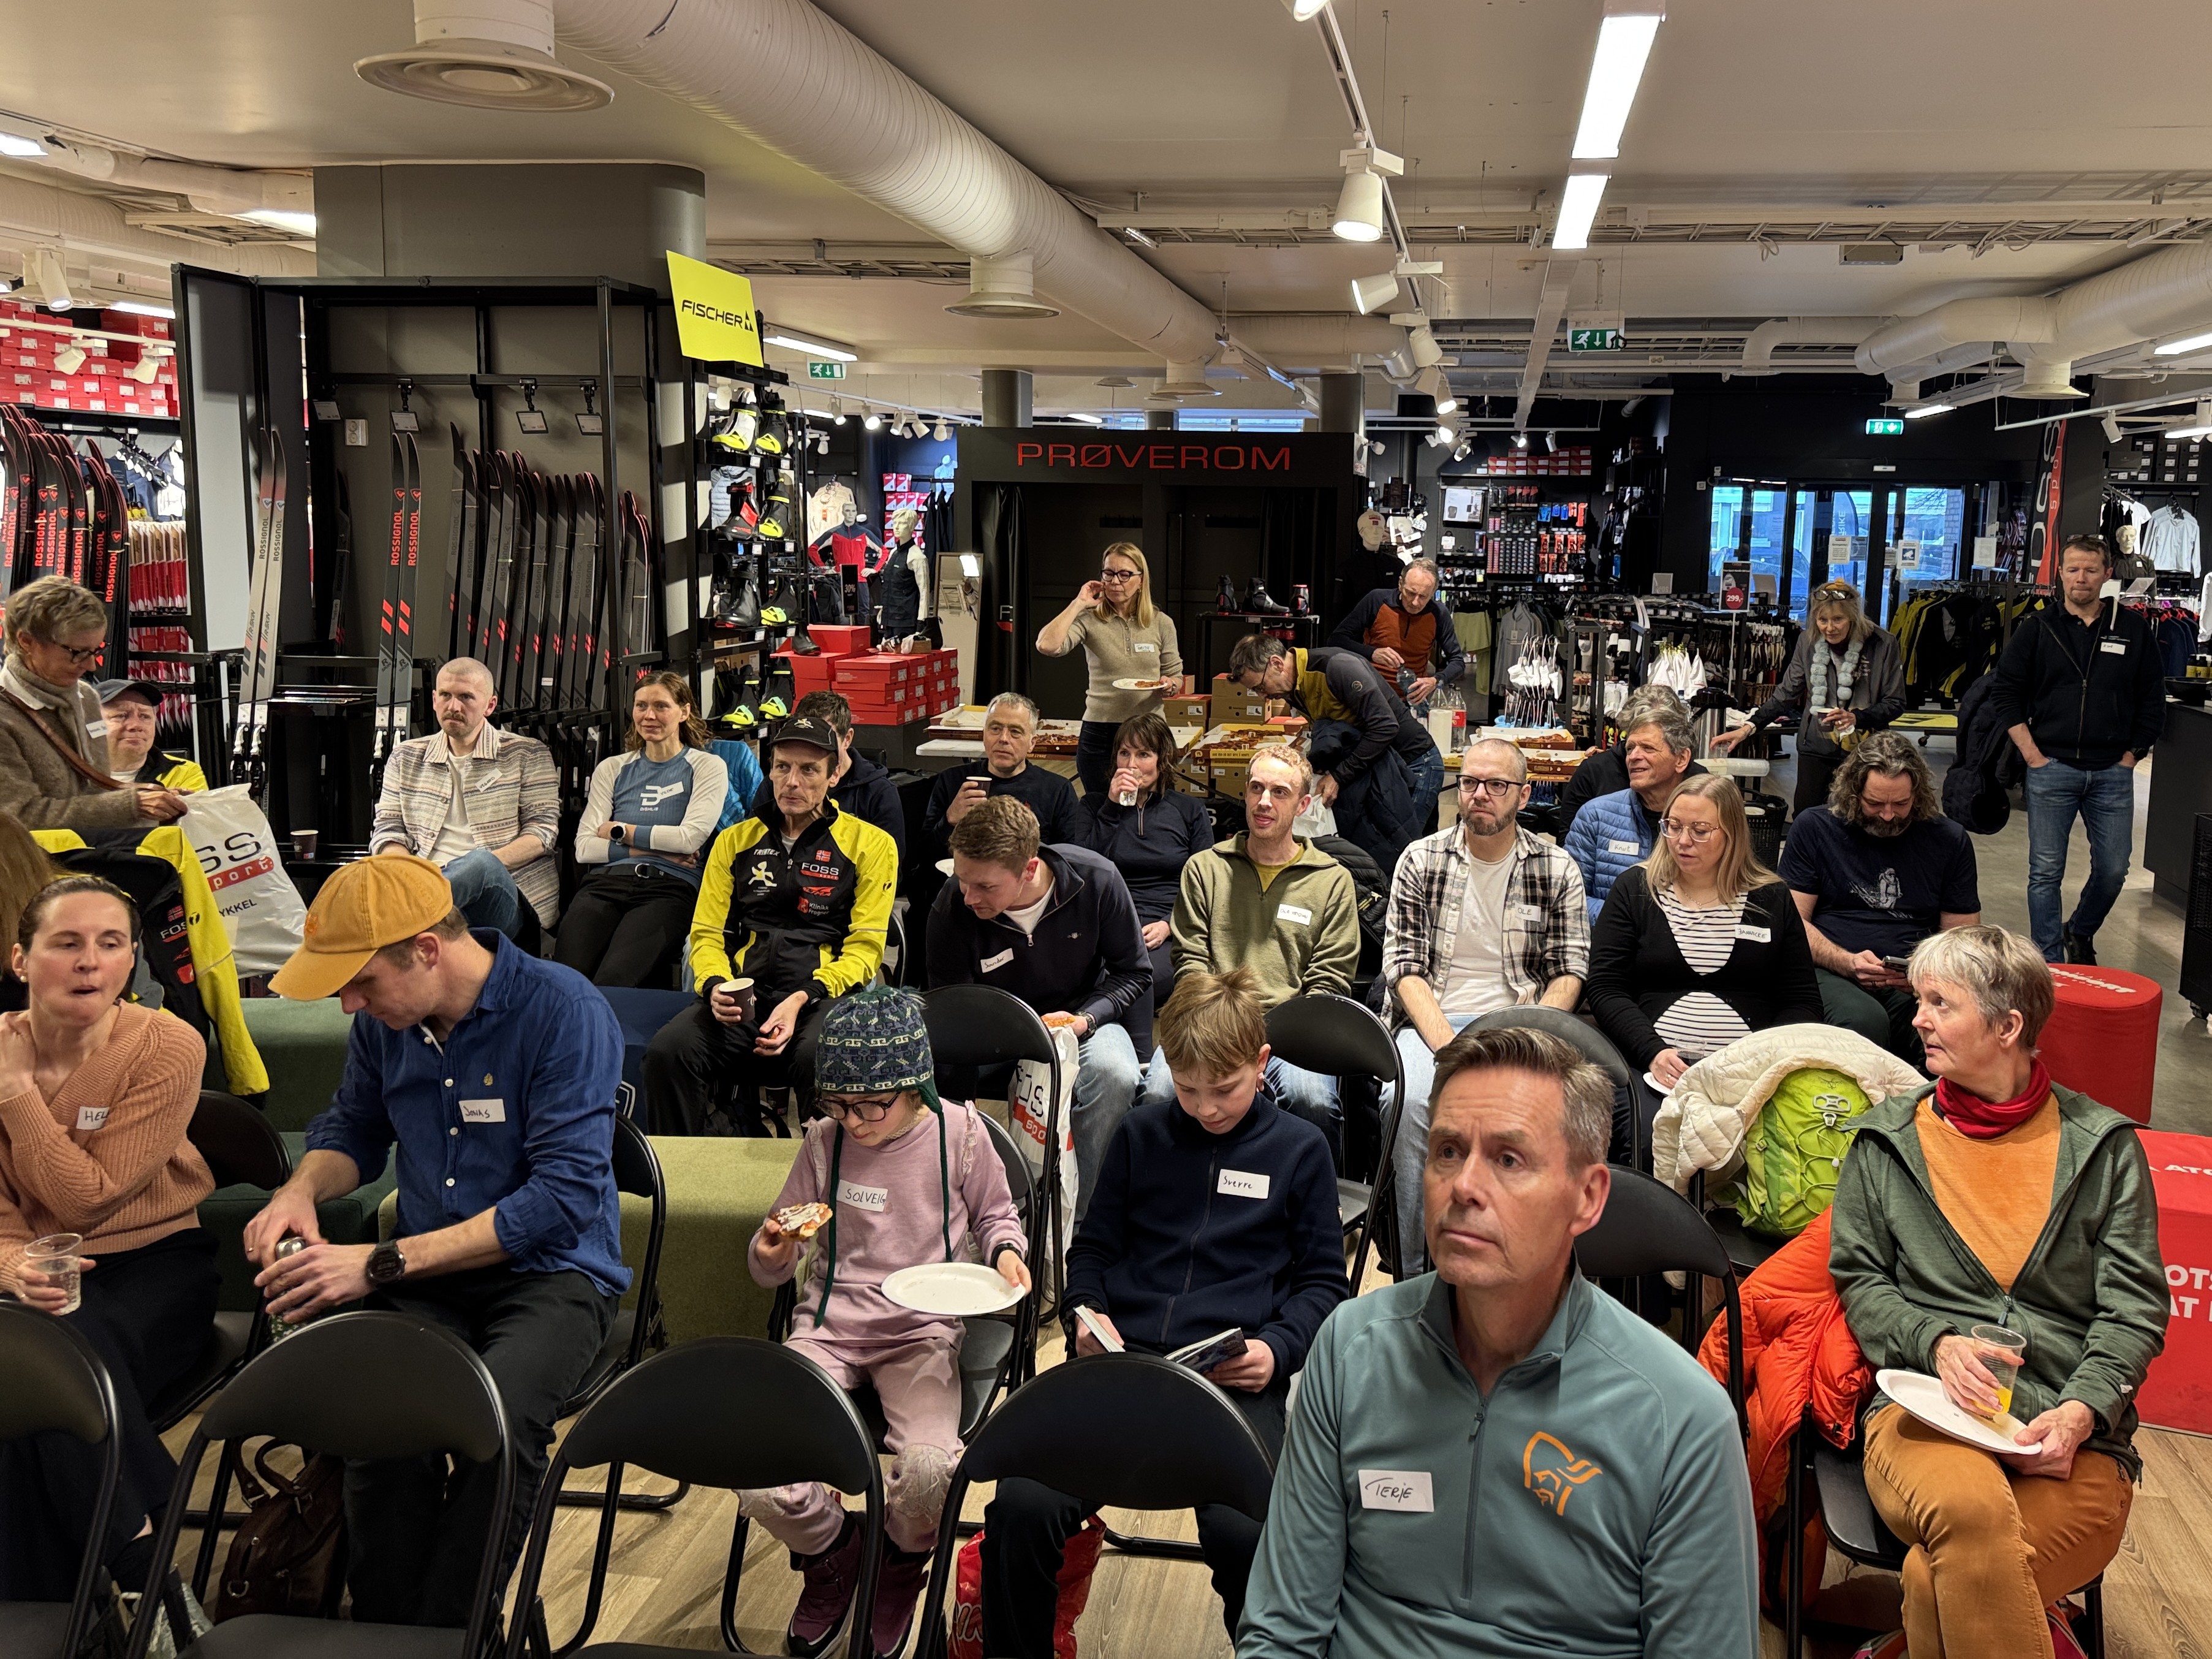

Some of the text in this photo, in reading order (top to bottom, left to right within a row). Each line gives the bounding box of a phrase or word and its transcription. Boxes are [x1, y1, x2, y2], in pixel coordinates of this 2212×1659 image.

[681, 299, 743, 330] FISCHER
[1017, 442, 1290, 471] PRØVEROM
[4, 508, 17, 567] ROSSIGNOL
[46, 509, 57, 567] ROSSIGNOL
[56, 527, 67, 576] OSSIGNOL
[259, 517, 269, 560] ROSSIGNOL
[273, 518, 282, 561] ROSSIGNOL
[391, 509, 403, 566] ROSSIGNOL
[407, 509, 419, 566] ROSSIGNOL
[1726, 594, 1743, 603] 299,-
[213, 856, 268, 888] port
[801, 862, 839, 876] FOSS
[219, 898, 257, 917] YKKEL
[160, 921, 187, 940] FOS
[845, 1188, 886, 1207] SOLVEIG
[1223, 1175, 1253, 1189] Sverre
